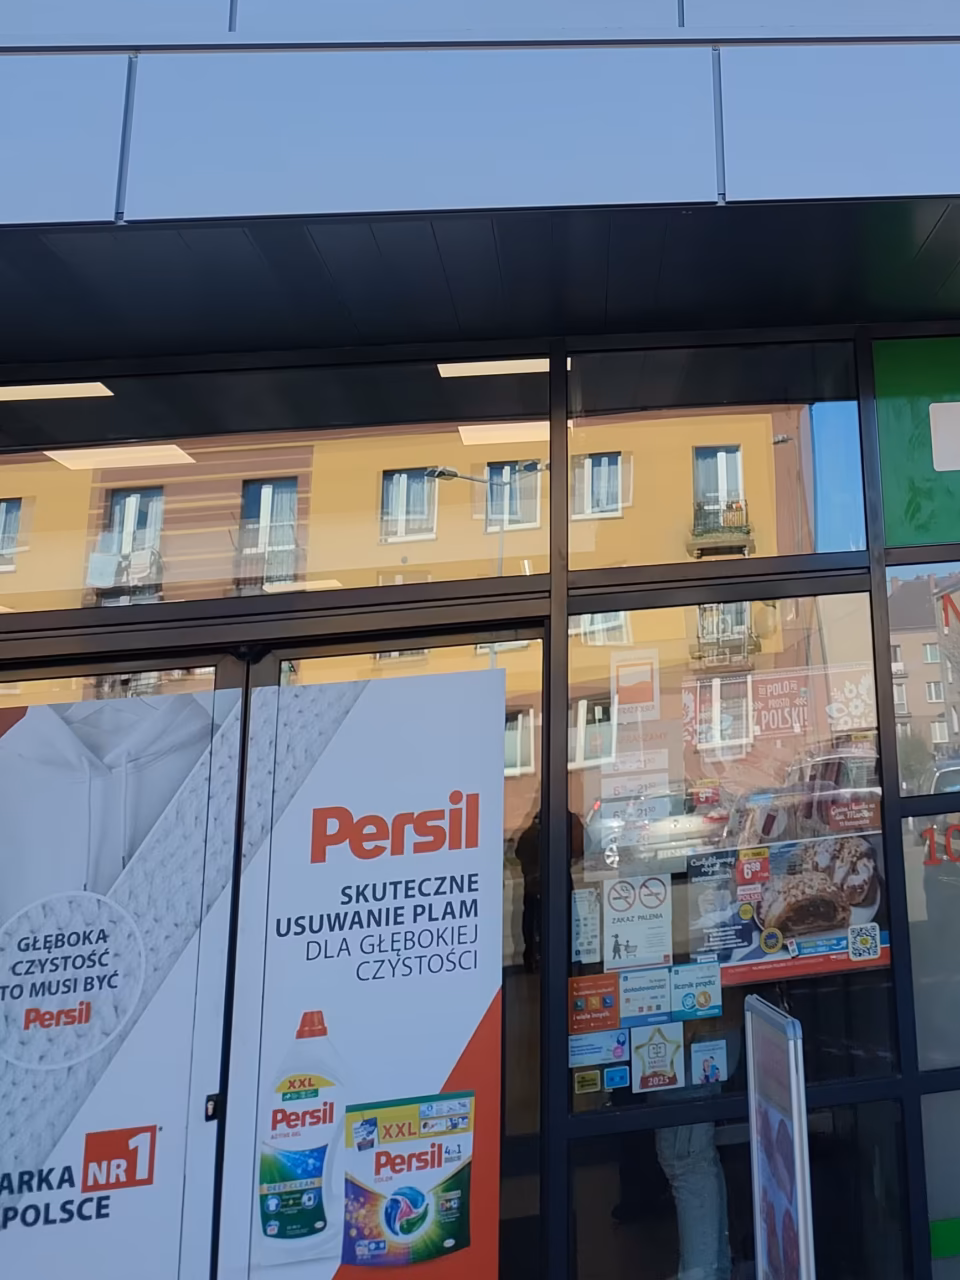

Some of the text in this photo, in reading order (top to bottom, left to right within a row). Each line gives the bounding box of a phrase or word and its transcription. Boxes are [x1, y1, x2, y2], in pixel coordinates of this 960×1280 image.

[767, 681, 790, 697] POLO
[768, 698, 790, 709] PROSTO
[761, 707, 809, 731] POLSKI!
[310, 789, 480, 864] Persil
[340, 873, 480, 906] SKUTECZNE
[275, 899, 479, 938] USUWANIE PLAM
[611, 913, 664, 925] ZAKAZ PALENIA
[17, 928, 109, 954] GŁĘBOKA
[306, 924, 478, 961] DLA GŁĘBOKIEJ
[11, 948, 110, 977] CZYSTOŚĆ
[356, 947, 478, 982] CZYSTOŚCI
[0, 970, 119, 1001] TO MUSI BYĆ
[23, 1001, 92, 1031] Persil
[287, 1077, 316, 1090] XXL
[648, 1075, 669, 1087] 2025
[271, 1101, 335, 1132] Persil
[381, 1122, 418, 1140] XXL
[87, 1158, 127, 1187] NR
[374, 1142, 443, 1176] Persil
[2, 1195, 111, 1230] POLSCE
